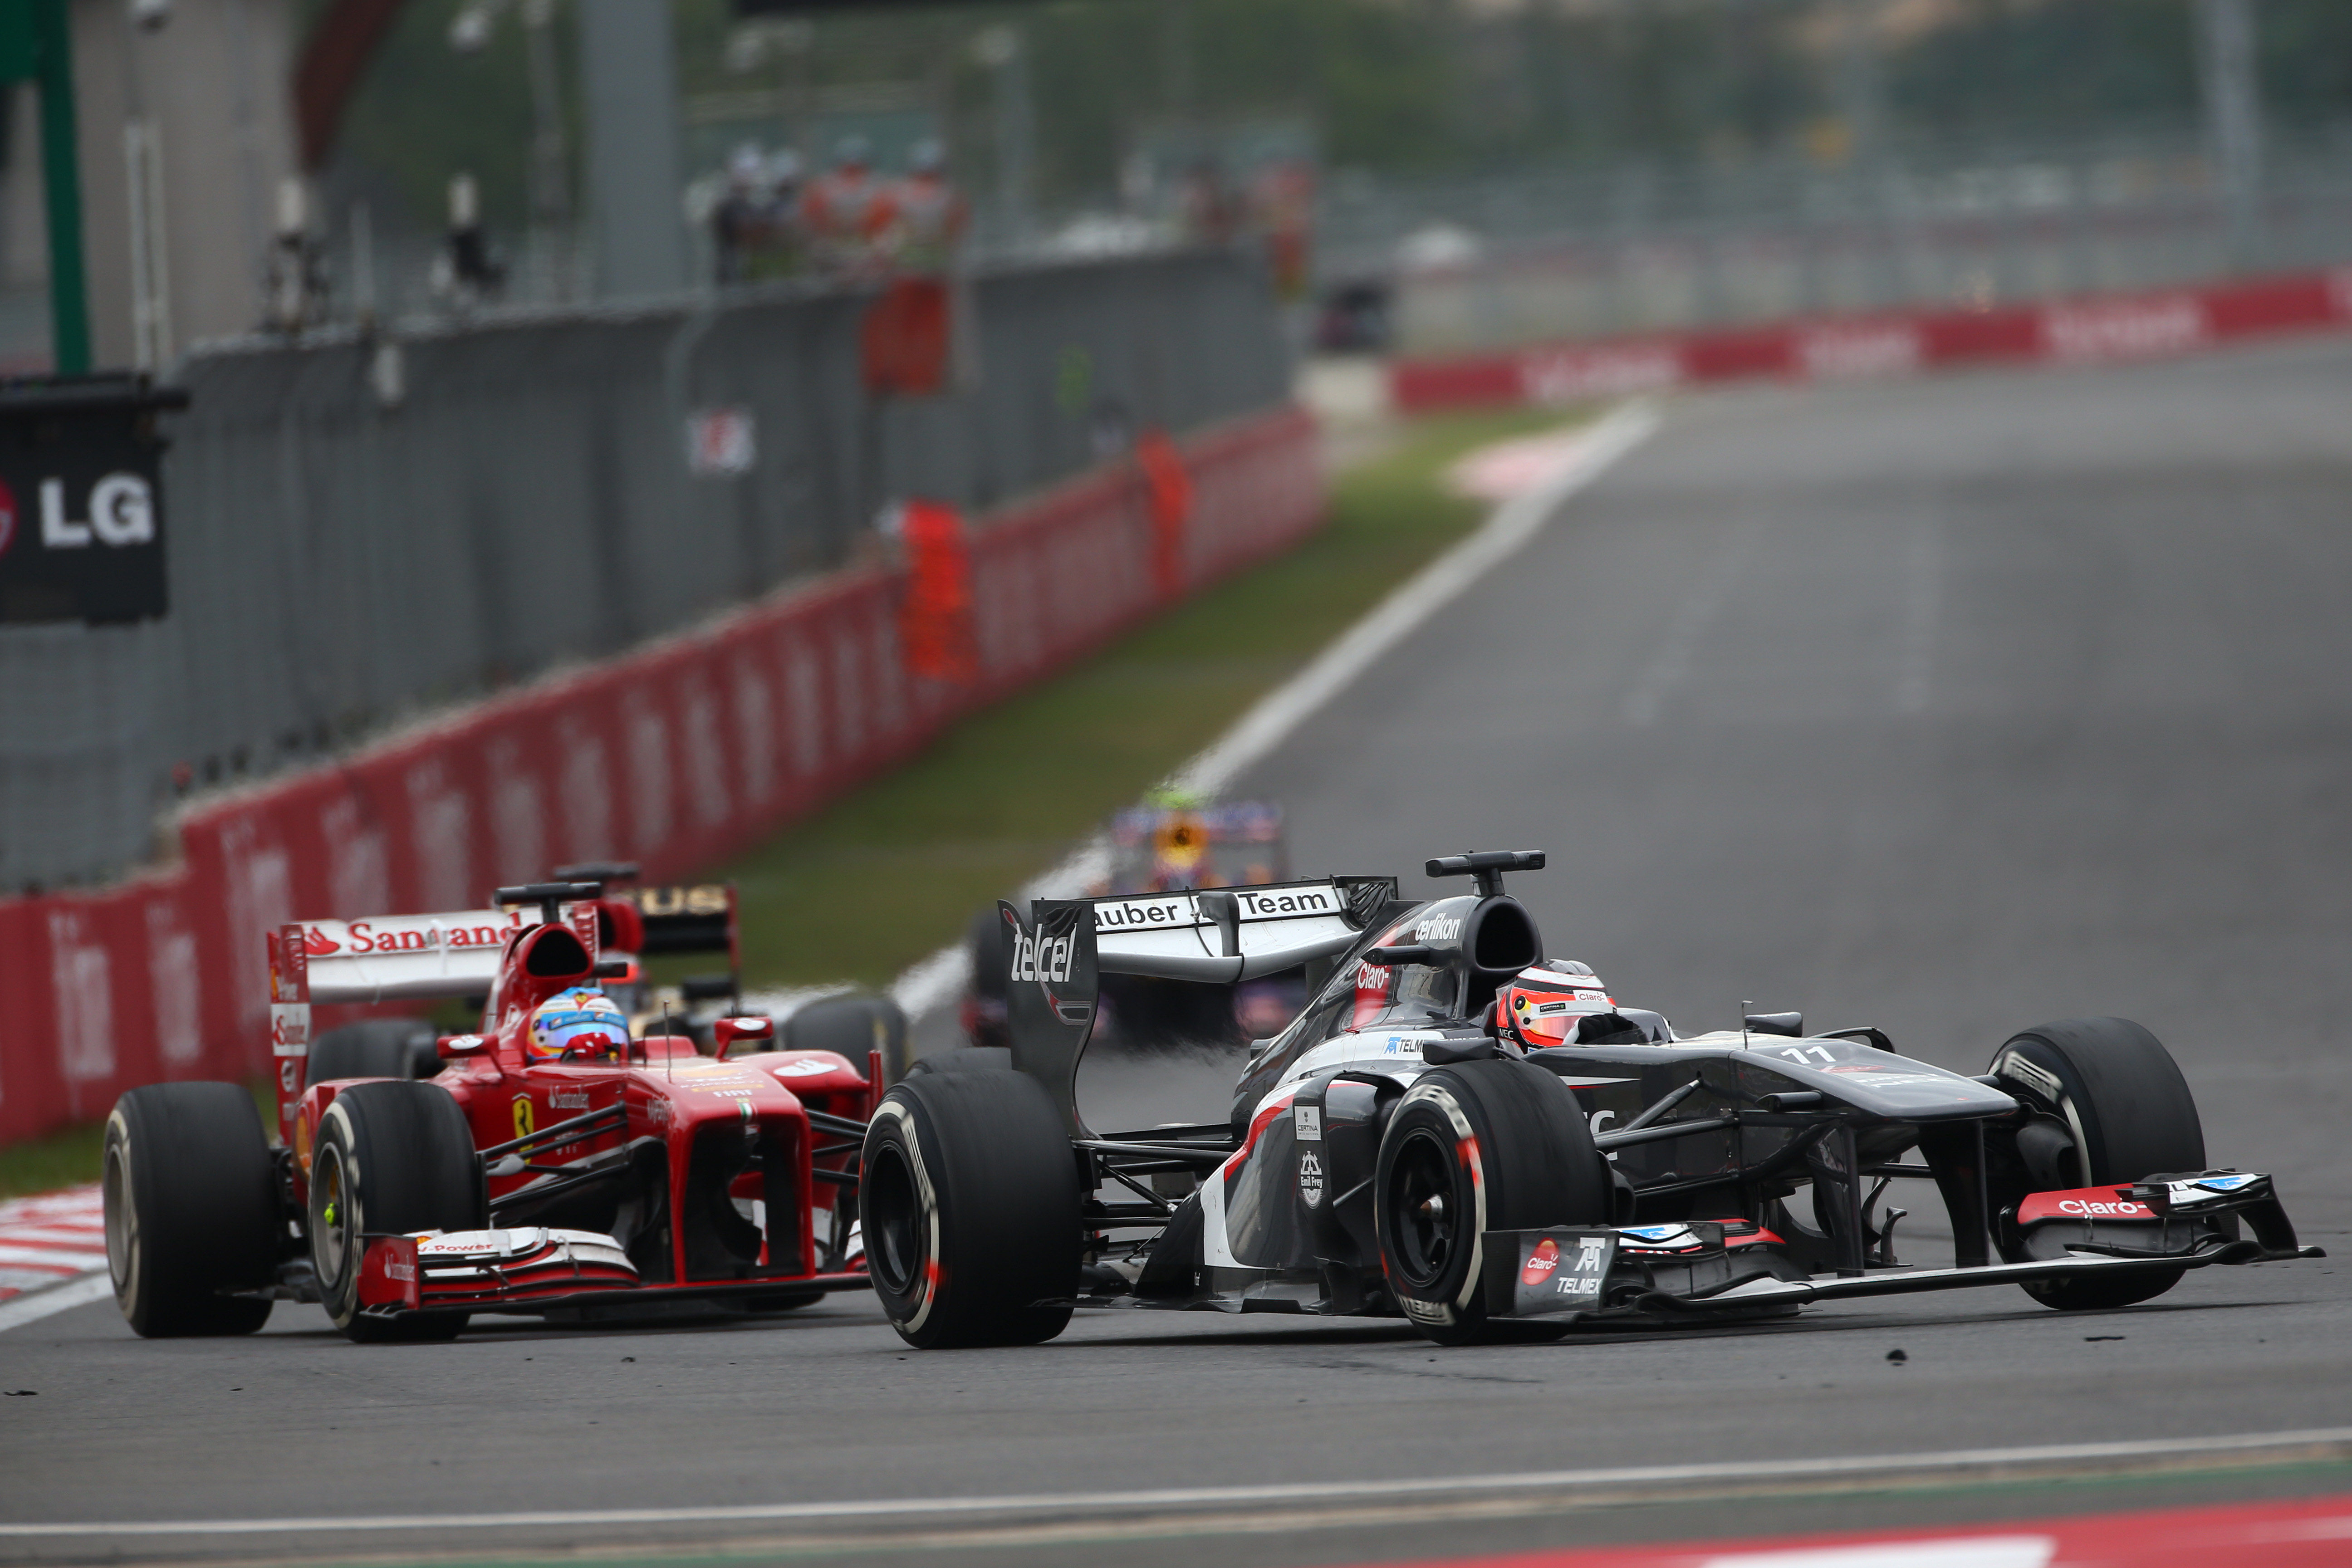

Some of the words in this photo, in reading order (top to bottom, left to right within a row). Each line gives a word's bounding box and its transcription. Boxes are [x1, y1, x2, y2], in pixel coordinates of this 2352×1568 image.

[39, 471, 155, 547] LG
[1095, 903, 1177, 926] auber
[1237, 892, 1329, 915] Team
[1011, 923, 1077, 982] telcel
[1499, 1028, 1514, 1040] NEC
[1399, 1039, 1424, 1053] TELM
[1780, 1046, 1837, 1064] 11
[1300, 1176, 1311, 1186] Emil
[1311, 1176, 1323, 1189] Frey
[2058, 1200, 2138, 1215] Claro
[1527, 1257, 1554, 1270] Claro
[1557, 1277, 1603, 1294] TELMEX
